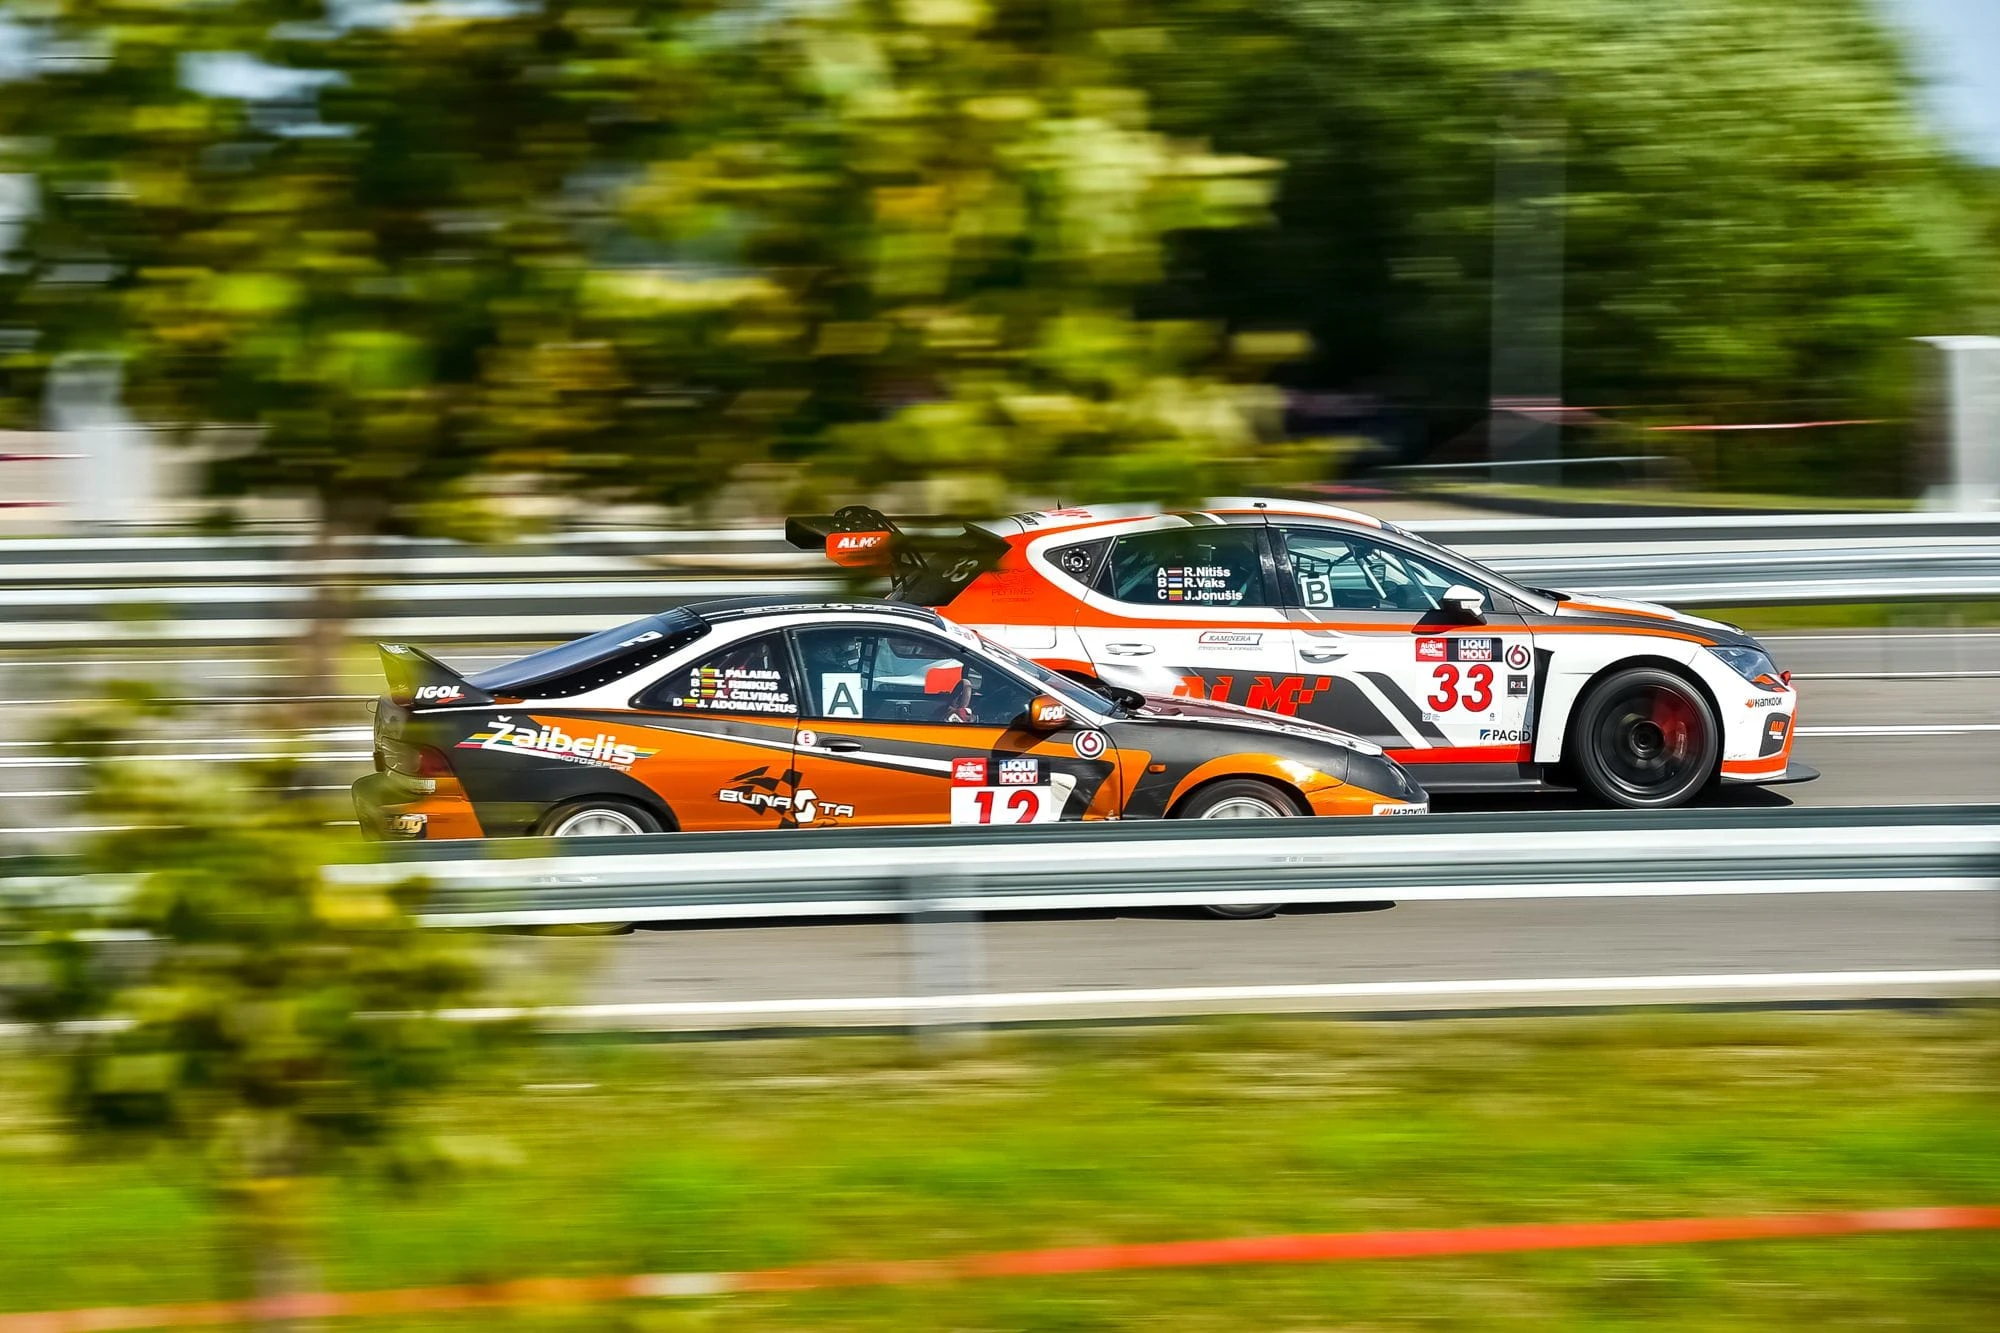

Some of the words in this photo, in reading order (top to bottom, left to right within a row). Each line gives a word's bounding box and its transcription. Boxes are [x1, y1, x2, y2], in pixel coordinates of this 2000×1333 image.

[1157, 568, 1167, 577] A
[1184, 566, 1231, 577] R.Nitišs
[1158, 578, 1167, 588] B
[1184, 578, 1226, 588] R.Vaks
[1158, 590, 1167, 599] C
[1184, 590, 1243, 600] J.Jonušis
[1306, 581, 1329, 605] B
[1460, 640, 1490, 649] LIQUI
[1460, 650, 1490, 659] MOLY
[690, 668, 699, 677] A
[690, 678, 700, 687] B
[1427, 664, 1494, 712] 33
[1511, 681, 1526, 689] R2L
[415, 685, 460, 699] IGOL
[690, 689, 700, 698] C
[673, 697, 683, 706] D
[827, 682, 859, 715] A
[1039, 706, 1066, 720] IGOL
[482, 715, 638, 765] Žaibelis
[803, 733, 811, 744] E
[1492, 730, 1531, 741] PAGID
[1001, 760, 1037, 772] LIQUI
[1001, 772, 1037, 783] MOLY
[974, 789, 1040, 824] 12
